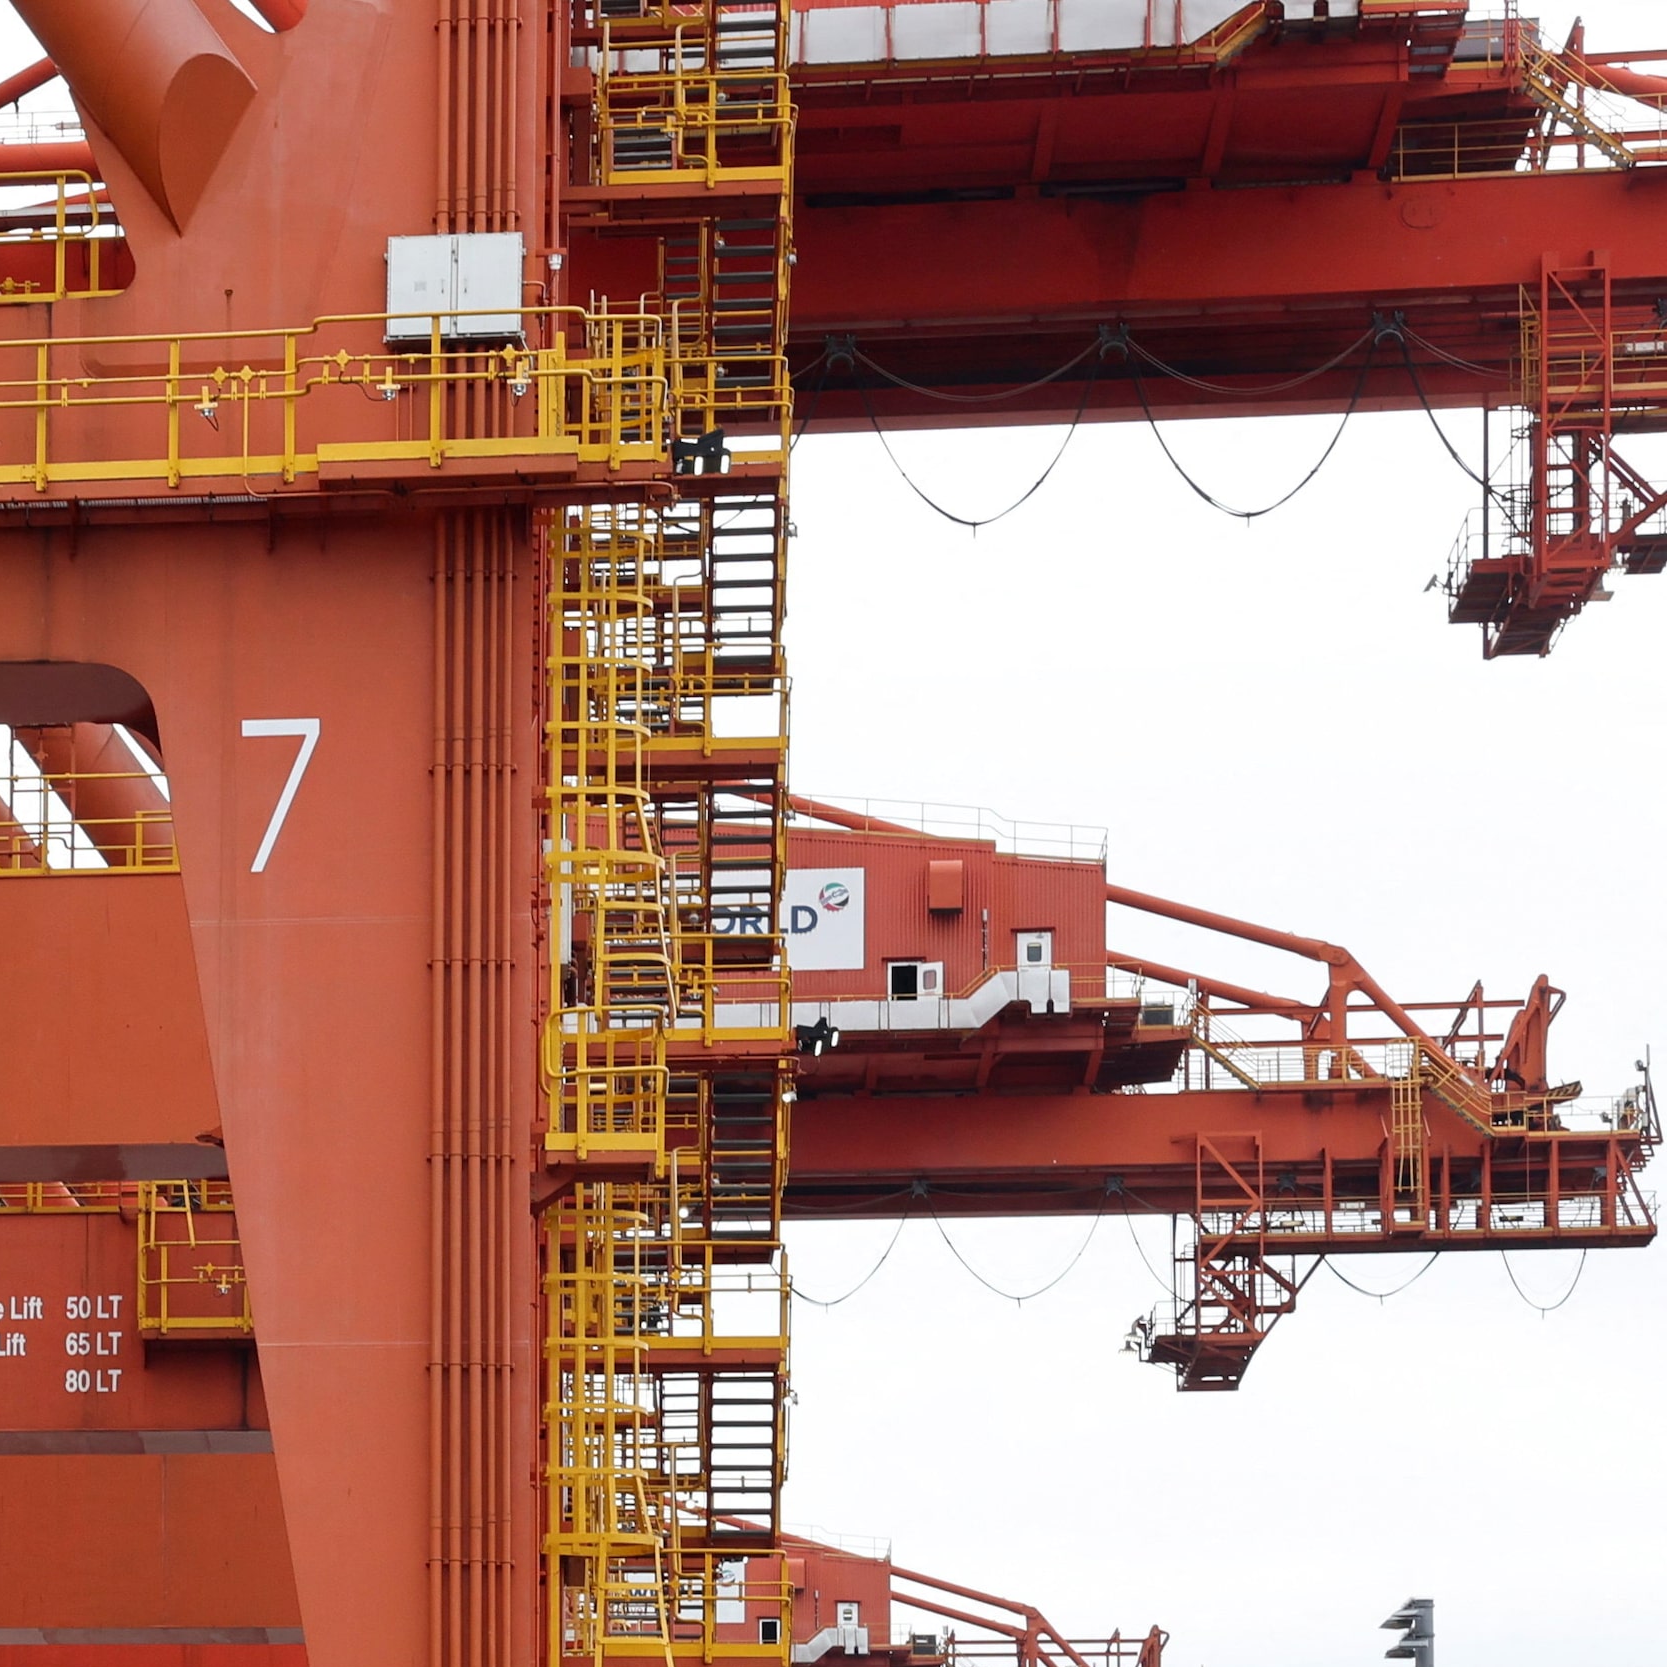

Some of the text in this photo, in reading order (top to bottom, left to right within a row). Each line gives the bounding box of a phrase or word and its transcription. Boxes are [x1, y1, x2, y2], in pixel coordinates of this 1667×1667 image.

[241, 719, 320, 873] 7
[10, 1296, 44, 1321] Lift
[66, 1297, 92, 1320] 50
[96, 1296, 123, 1320] LT
[66, 1334, 92, 1357] 65
[96, 1332, 123, 1356] LT
[65, 1370, 92, 1393] 80
[95, 1369, 122, 1392] LT
